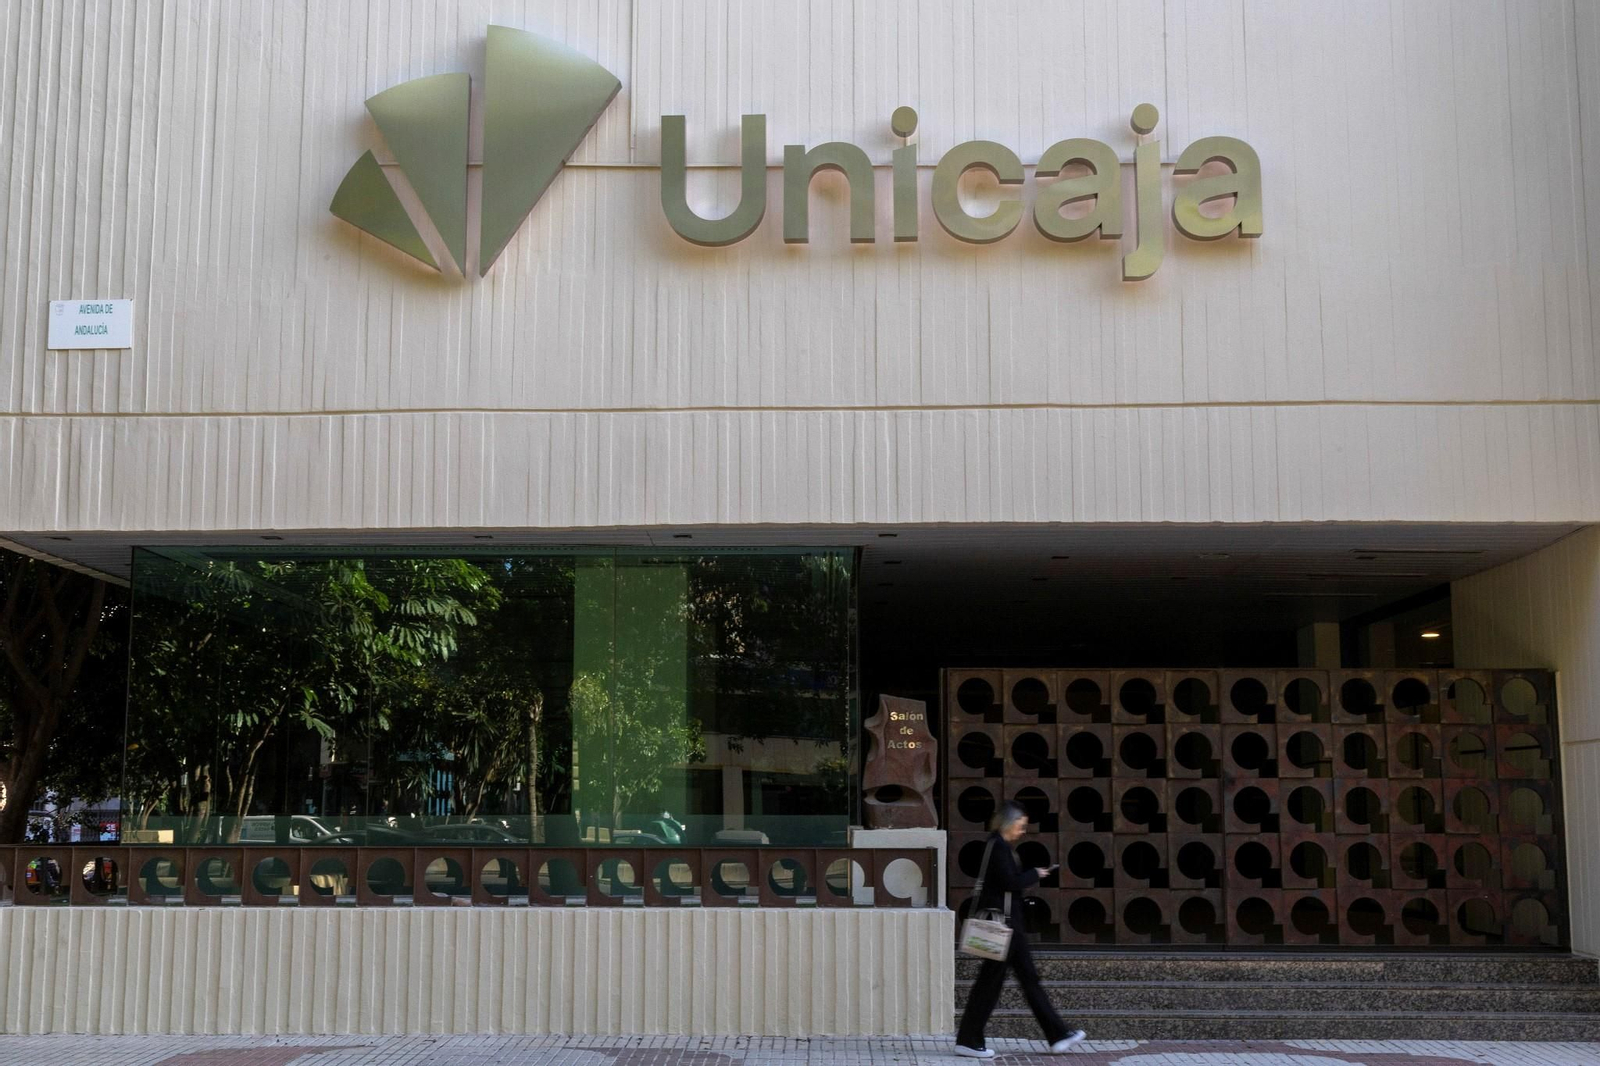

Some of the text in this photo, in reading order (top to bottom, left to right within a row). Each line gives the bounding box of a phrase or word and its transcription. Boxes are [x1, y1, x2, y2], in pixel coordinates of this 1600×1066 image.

[661, 103, 1263, 281] Unicaja
[79, 304, 113, 314] AVENIDA DE
[75, 322, 108, 335] ANDALUCÍA
[899, 726, 914, 735] de
[887, 739, 922, 749] Actos
